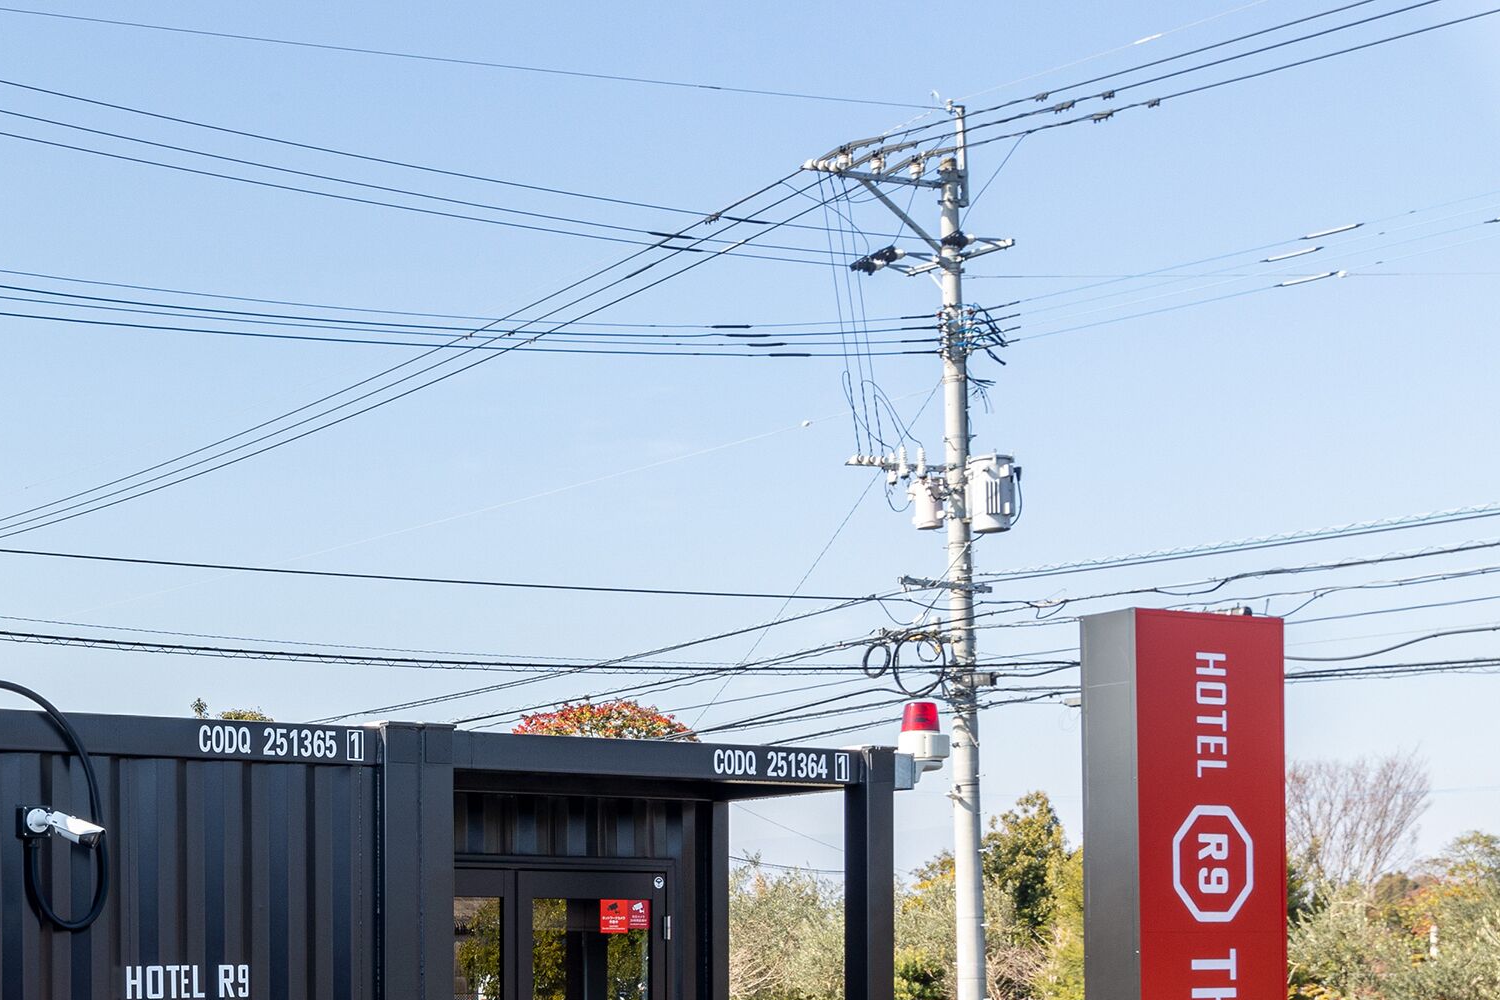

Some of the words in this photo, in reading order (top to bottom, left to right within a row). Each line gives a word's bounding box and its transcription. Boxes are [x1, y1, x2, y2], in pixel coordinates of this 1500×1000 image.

[1195, 651, 1228, 778] HOTEL
[198, 724, 252, 754] CODQ
[262, 727, 338, 759] 251365
[349, 731, 361, 760] 1
[713, 748, 757, 776] CODQ
[766, 751, 829, 779] 251364
[837, 754, 847, 780] 1
[1197, 832, 1229, 894] R9
[125, 964, 206, 1000] HOTEL
[218, 964, 250, 998] R9
